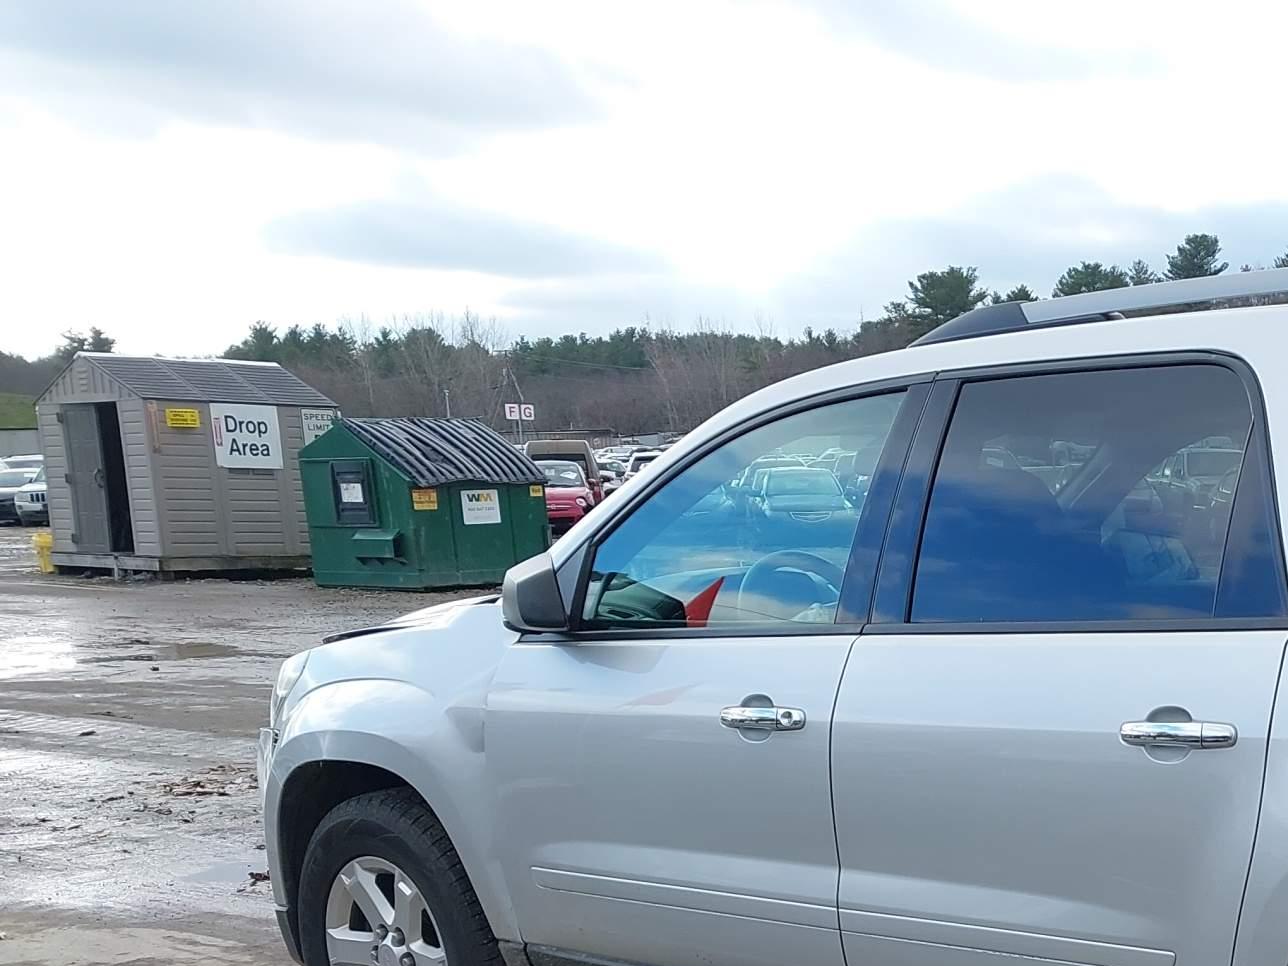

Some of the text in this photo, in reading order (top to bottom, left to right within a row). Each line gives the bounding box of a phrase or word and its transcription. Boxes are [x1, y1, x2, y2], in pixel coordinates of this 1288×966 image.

[303, 413, 333, 421] SPEED
[508, 406, 516, 418] F
[523, 406, 533, 418] G
[224, 415, 268, 438] Drop
[307, 423, 330, 431] LIMIT
[229, 438, 271, 457] Area
[466, 492, 494, 503] WM
